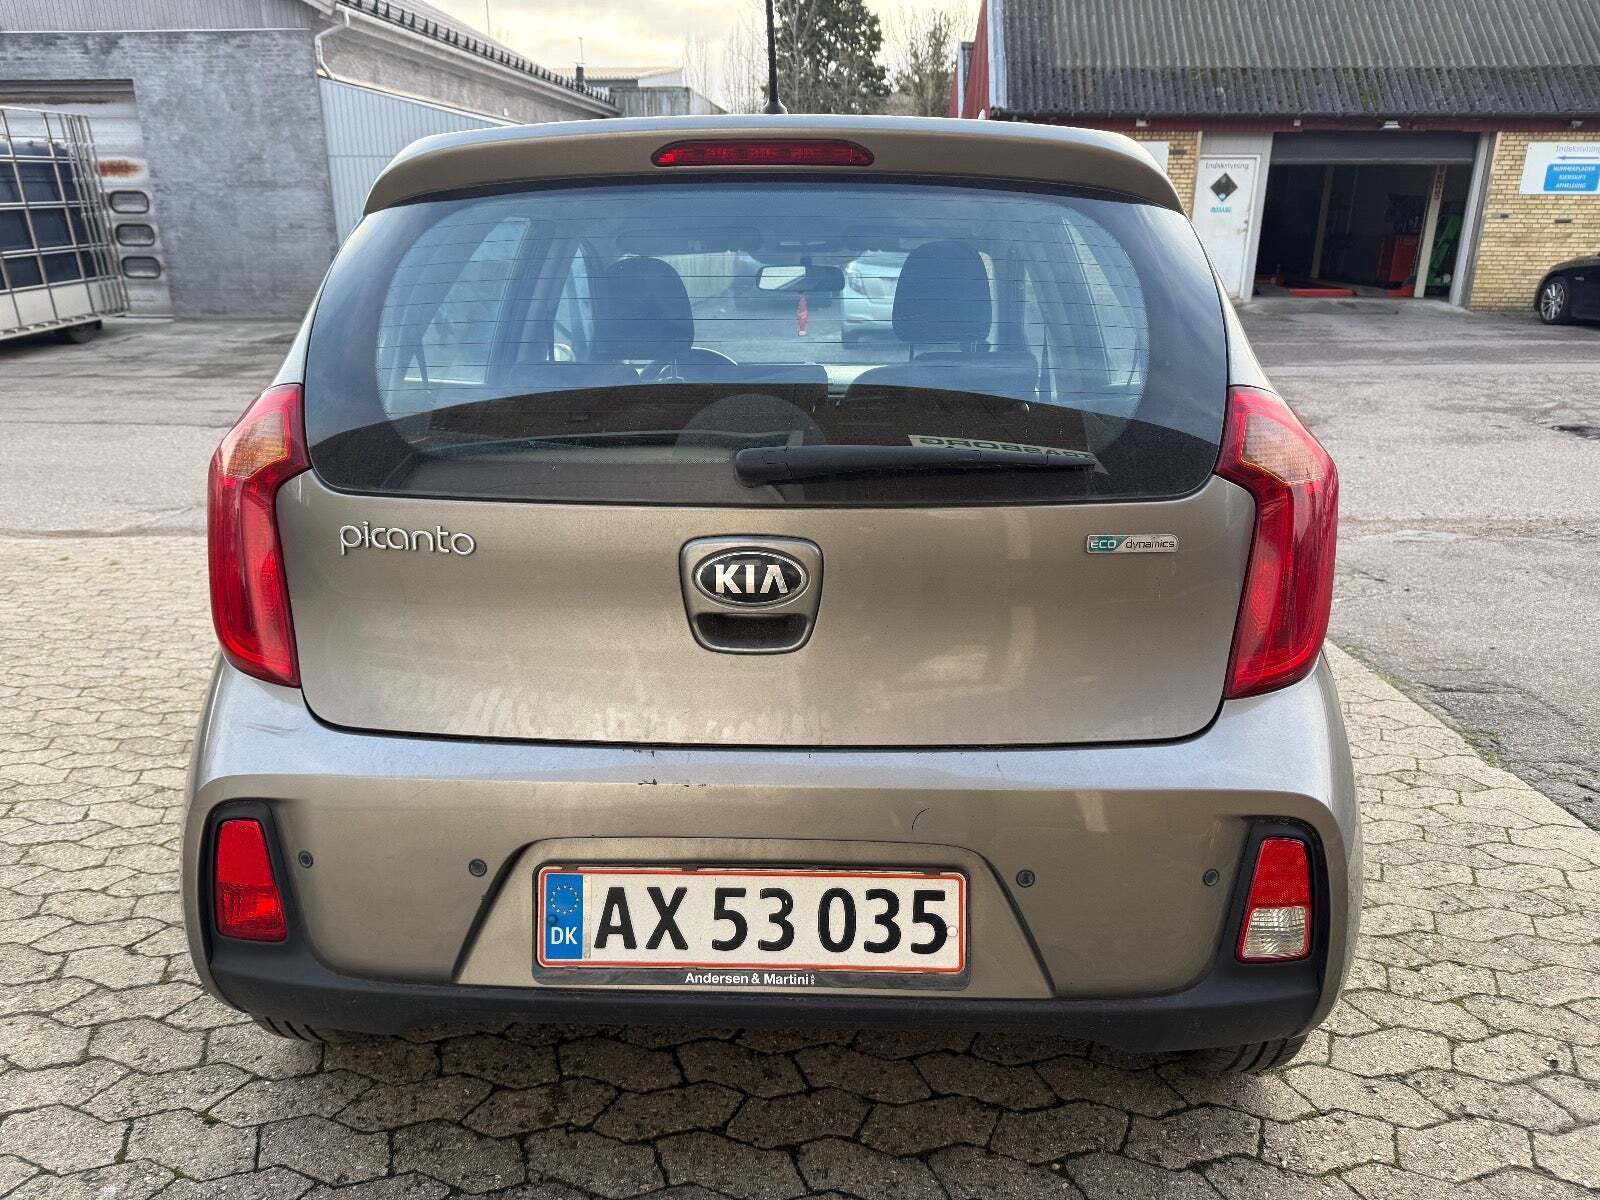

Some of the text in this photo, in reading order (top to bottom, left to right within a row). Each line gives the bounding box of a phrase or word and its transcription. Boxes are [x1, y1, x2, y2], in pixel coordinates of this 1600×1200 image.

[339, 520, 477, 556] picanto
[1090, 539, 1175, 550] ECO dynamics
[714, 564, 789, 594] KIA
[593, 886, 948, 955] AX 53 035
[550, 926, 578, 945] DK
[685, 972, 749, 984] Andersen
[751, 972, 761, 985] &
[763, 973, 809, 985] Martini
